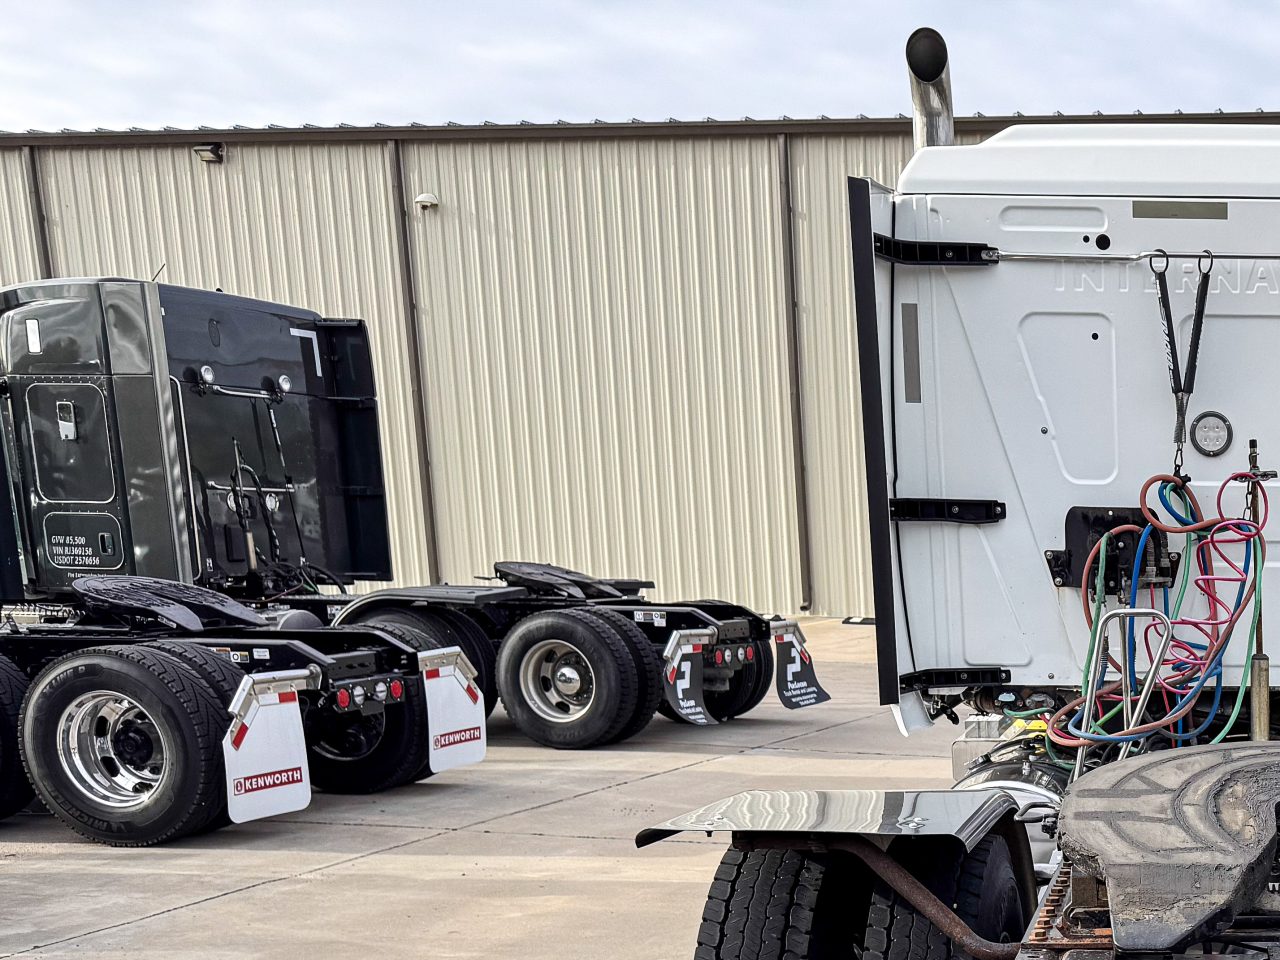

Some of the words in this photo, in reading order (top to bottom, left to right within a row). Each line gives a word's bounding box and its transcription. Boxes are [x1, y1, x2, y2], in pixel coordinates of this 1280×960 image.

[51, 536, 65, 544] GVW
[65, 536, 86, 545] 85,500
[52, 546, 64, 555] VIN
[54, 556, 73, 565] USDOT
[440, 729, 480, 746] KENWORTH
[245, 770, 301, 791] KENWORTH
